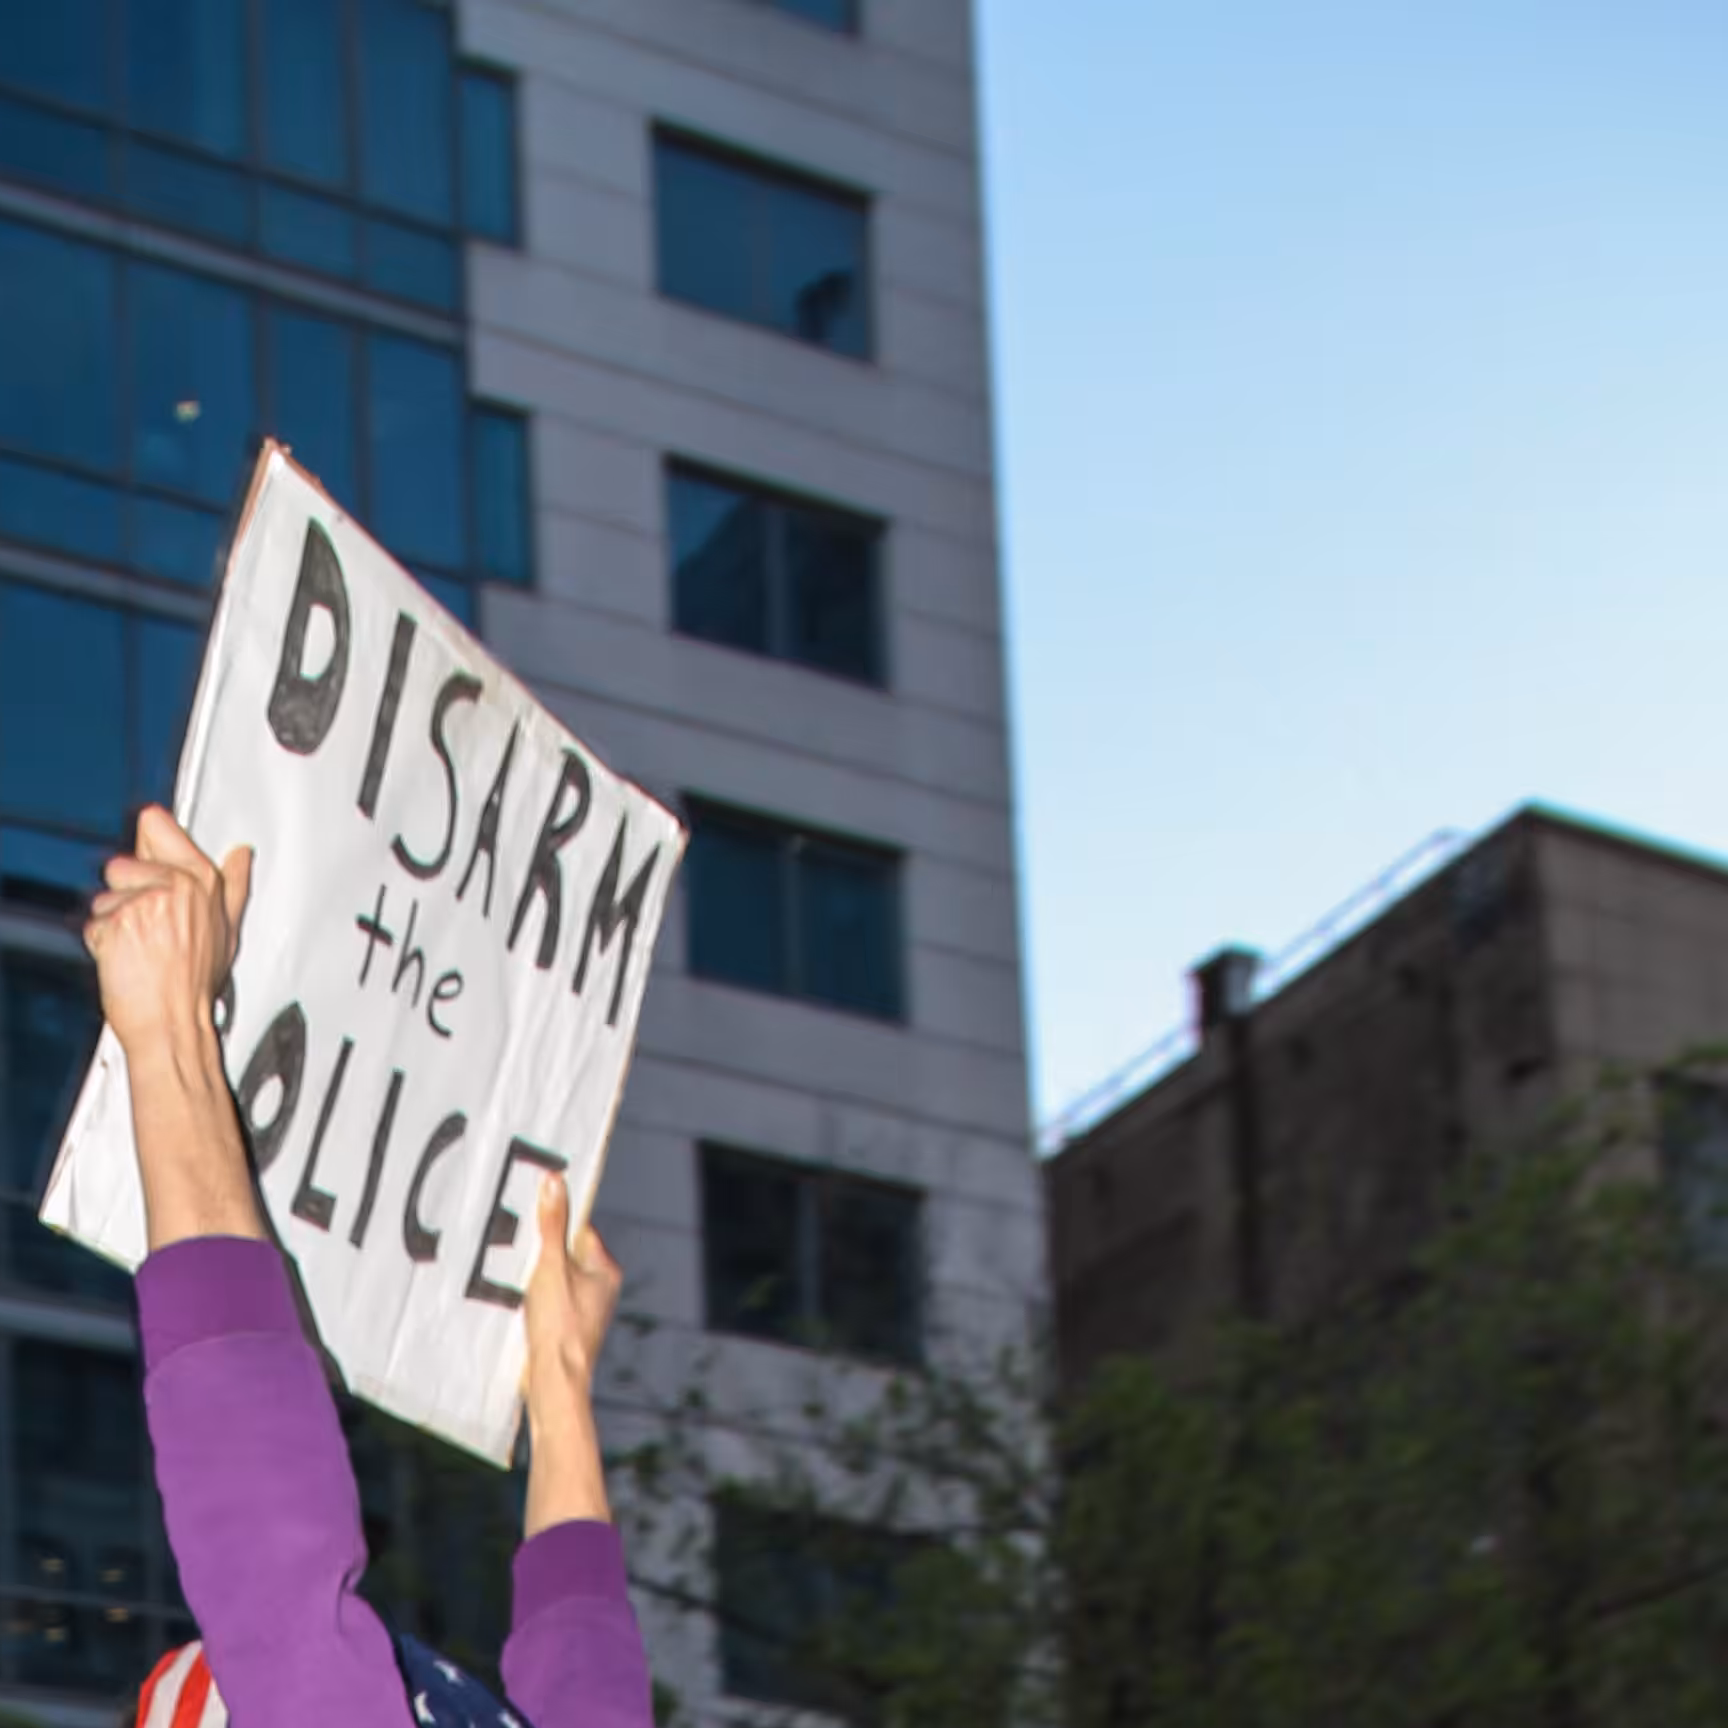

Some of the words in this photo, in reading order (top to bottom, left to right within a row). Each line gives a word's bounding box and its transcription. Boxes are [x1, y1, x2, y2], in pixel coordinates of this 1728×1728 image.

[267, 516, 661, 1027] DISARM
[356, 883, 465, 1039] the
[214, 968, 569, 1311] OLICE
